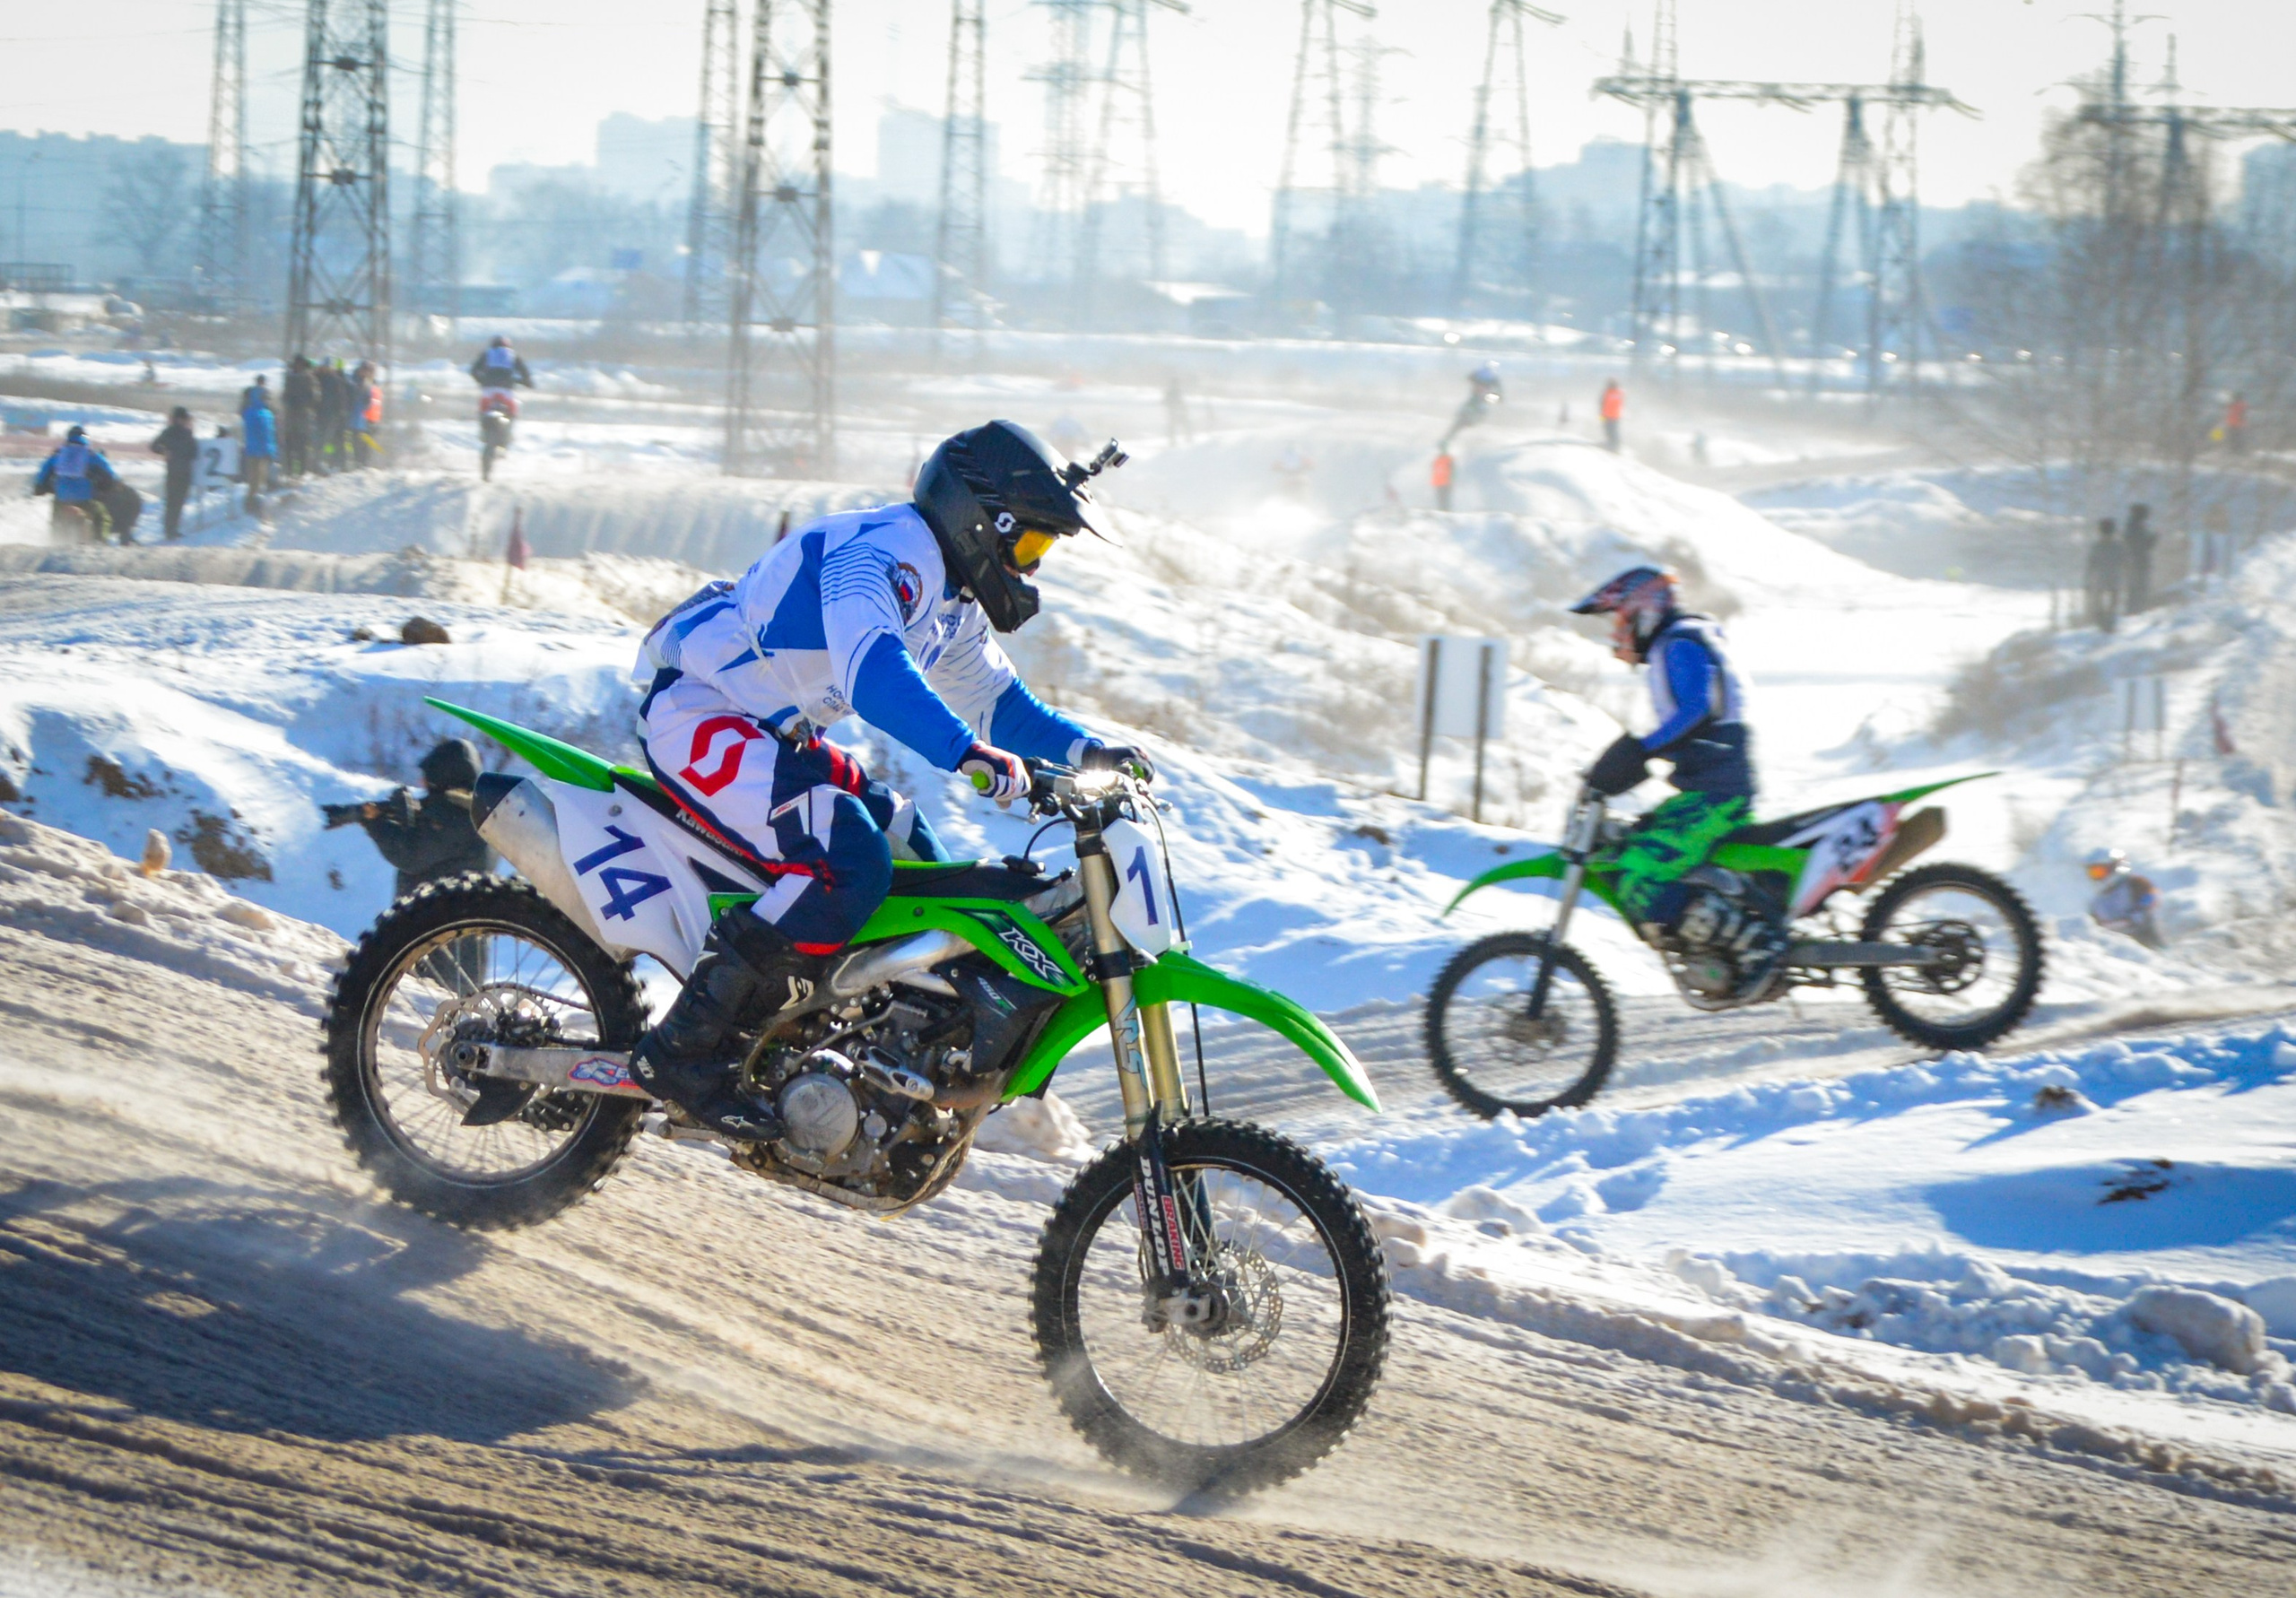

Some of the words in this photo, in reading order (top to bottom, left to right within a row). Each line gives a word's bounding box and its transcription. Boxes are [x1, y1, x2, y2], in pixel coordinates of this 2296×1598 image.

[204, 447, 223, 476] 2
[573, 825, 673, 921] 14
[1126, 846, 1159, 925] 1
[998, 926, 1065, 979] KX
[1140, 1156, 1170, 1276] DUNLOP
[1161, 1196, 1185, 1270] BRAKING
